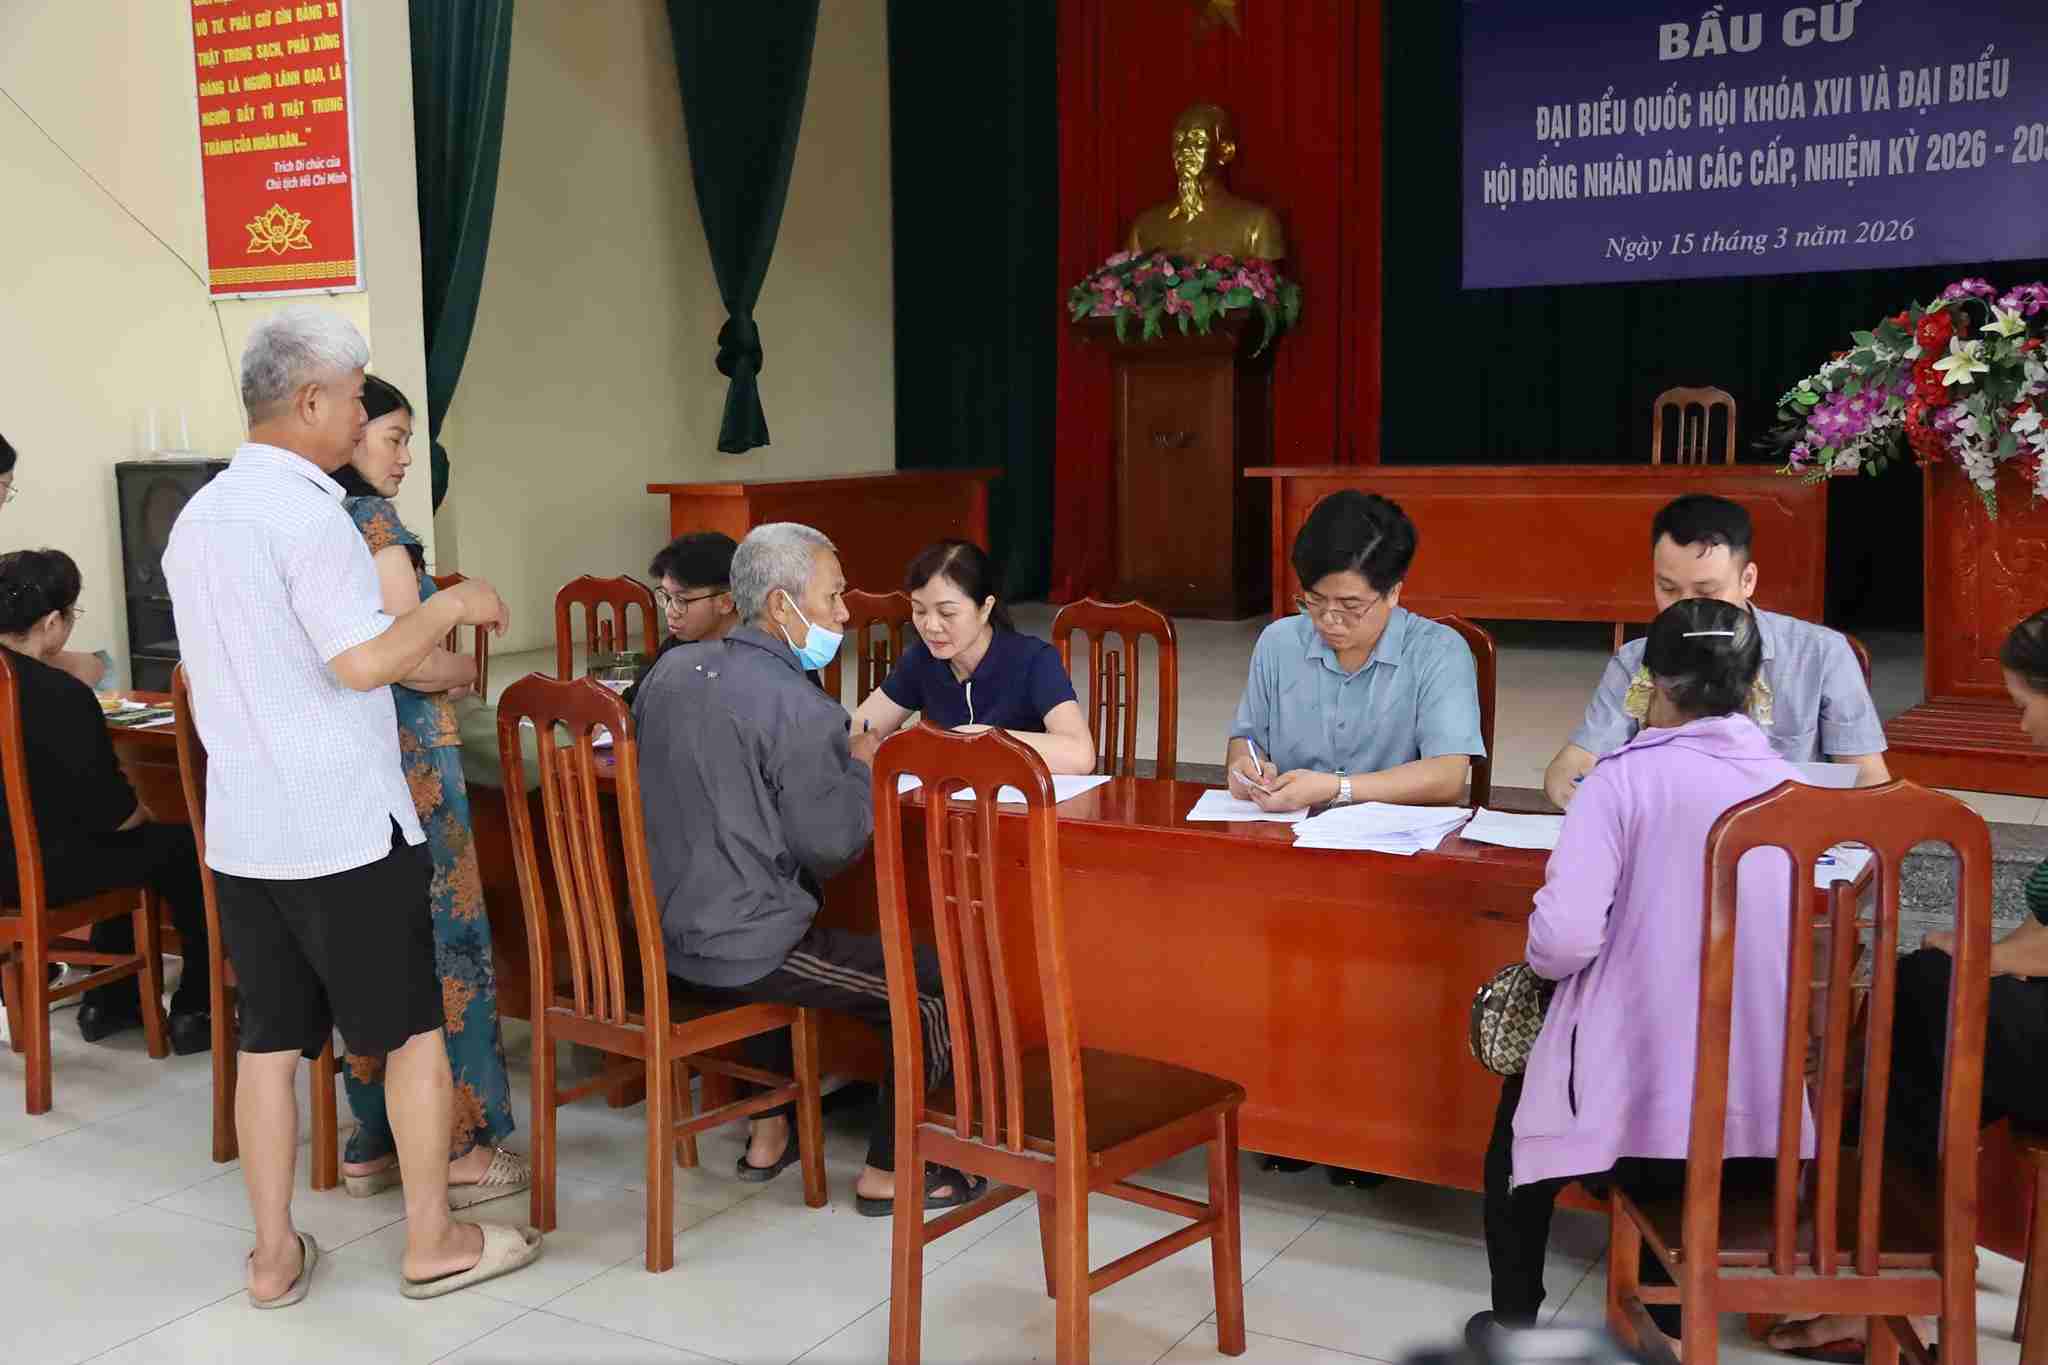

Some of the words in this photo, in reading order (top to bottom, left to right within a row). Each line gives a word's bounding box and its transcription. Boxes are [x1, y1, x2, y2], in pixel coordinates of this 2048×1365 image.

[230, 10, 251, 32] PHẢI
[287, 33, 310, 54] PHẢI
[1659, 5, 1763, 61] BẦU
[1536, 103, 1571, 148] ĐẠI
[1578, 85, 1627, 138] BIỂU
[1633, 81, 1692, 137] QUỐC
[1699, 82, 1737, 135] HỘI
[1744, 76, 1806, 123] KHÓA
[1813, 76, 1852, 117] XVI
[1860, 65, 1891, 113] VÀ
[1898, 66, 1941, 115] ĐẠI
[1950, 43, 2010, 103] BIỂU
[1484, 161, 1516, 211] HỘI
[1522, 154, 1578, 202] ĐỒNG
[1584, 152, 1642, 198] NHÂN
[1649, 149, 1693, 193] DÂN
[1699, 145, 1743, 189] CÁC
[1750, 134, 1797, 188] CẤP,
[1804, 133, 1881, 187] NHIỆM
[1888, 128, 1921, 176] KỲ
[1925, 129, 1987, 172] 2026
[1605, 237, 1663, 262] Ngày
[1669, 233, 1696, 255] 15
[1702, 230, 1769, 255] tháng
[1774, 227, 1788, 249] 3
[1795, 224, 1847, 248] năm
[1855, 217, 1916, 244] 2026
